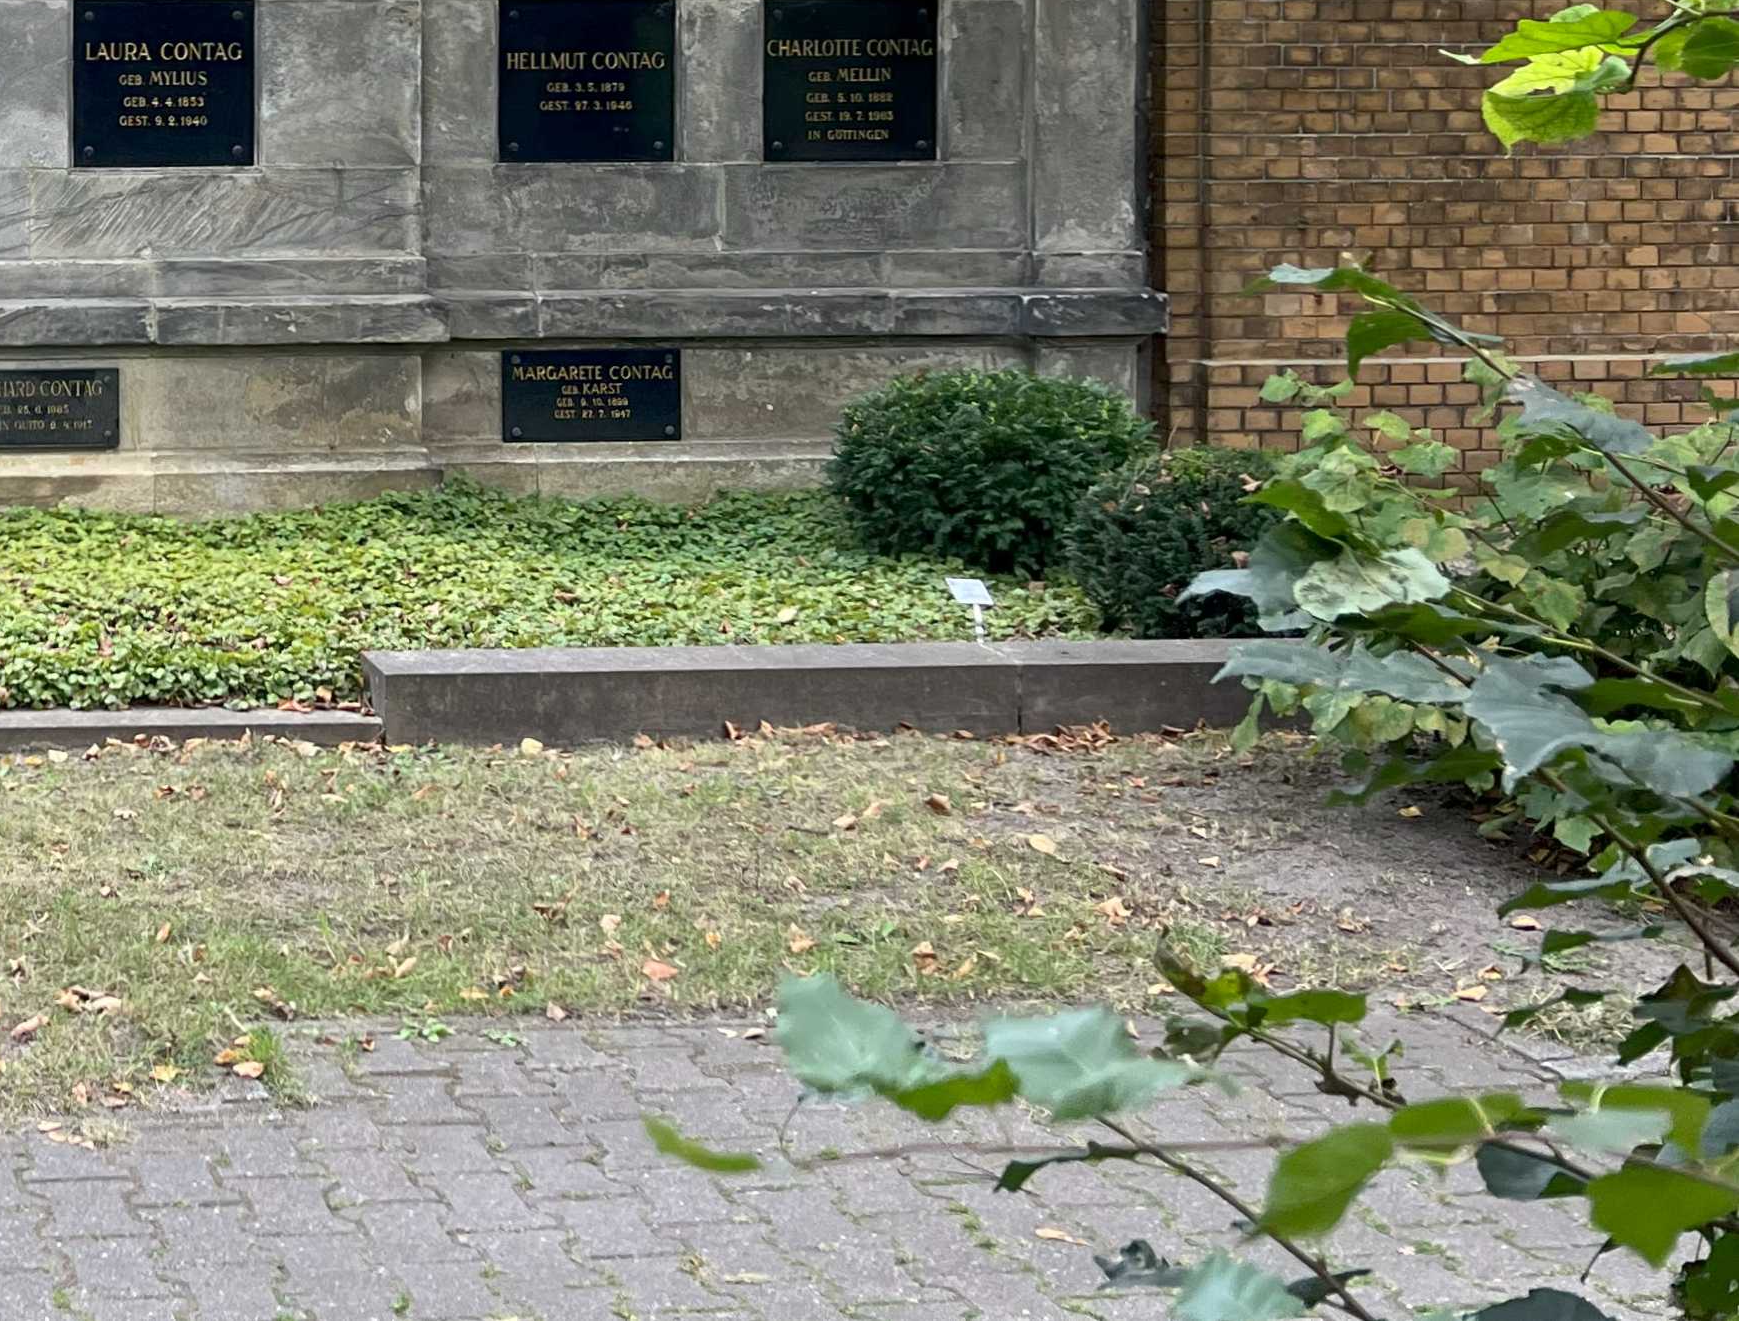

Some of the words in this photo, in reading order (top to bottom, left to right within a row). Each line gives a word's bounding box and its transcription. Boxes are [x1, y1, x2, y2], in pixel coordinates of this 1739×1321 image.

[85, 42, 152, 61] LAURA
[160, 42, 243, 61] CONTAG
[766, 39, 862, 57] CHARLOTTE
[866, 39, 934, 57] CONTAG
[506, 52, 587, 70] HELLMUT
[591, 52, 665, 70] CONTAG
[118, 74, 145, 86] GEB.
[149, 70, 208, 86] MYLIUS
[836, 67, 892, 82] MELLIN
[546, 82, 572, 93] GEB.
[574, 82, 586, 93] 3.
[587, 82, 598, 93] 5.
[600, 82, 626, 93] 1879
[123, 96, 149, 107] GEB.
[151, 96, 162, 107] 4.
[164, 96, 176, 107] 4.
[177, 96, 205, 107] 1853
[806, 92, 831, 103] GEB.
[837, 92, 847, 103] 5.
[850, 92, 864, 103] 10.
[539, 100, 572, 111] GEST.
[593, 100, 604, 111] 3.
[119, 115, 152, 127] GEST.
[154, 115, 166, 127] 9.
[168, 115, 179, 127] 2.
[180, 115, 208, 127] 1940
[805, 111, 834, 122] GEST.
[807, 129, 821, 141] IN
[512, 365, 603, 380] MARGARETE
[608, 365, 673, 380] CONTAG
[40, 380, 103, 399] CONTAG
[582, 382, 623, 395] KARST
[13, 420, 45, 431] QUITO
